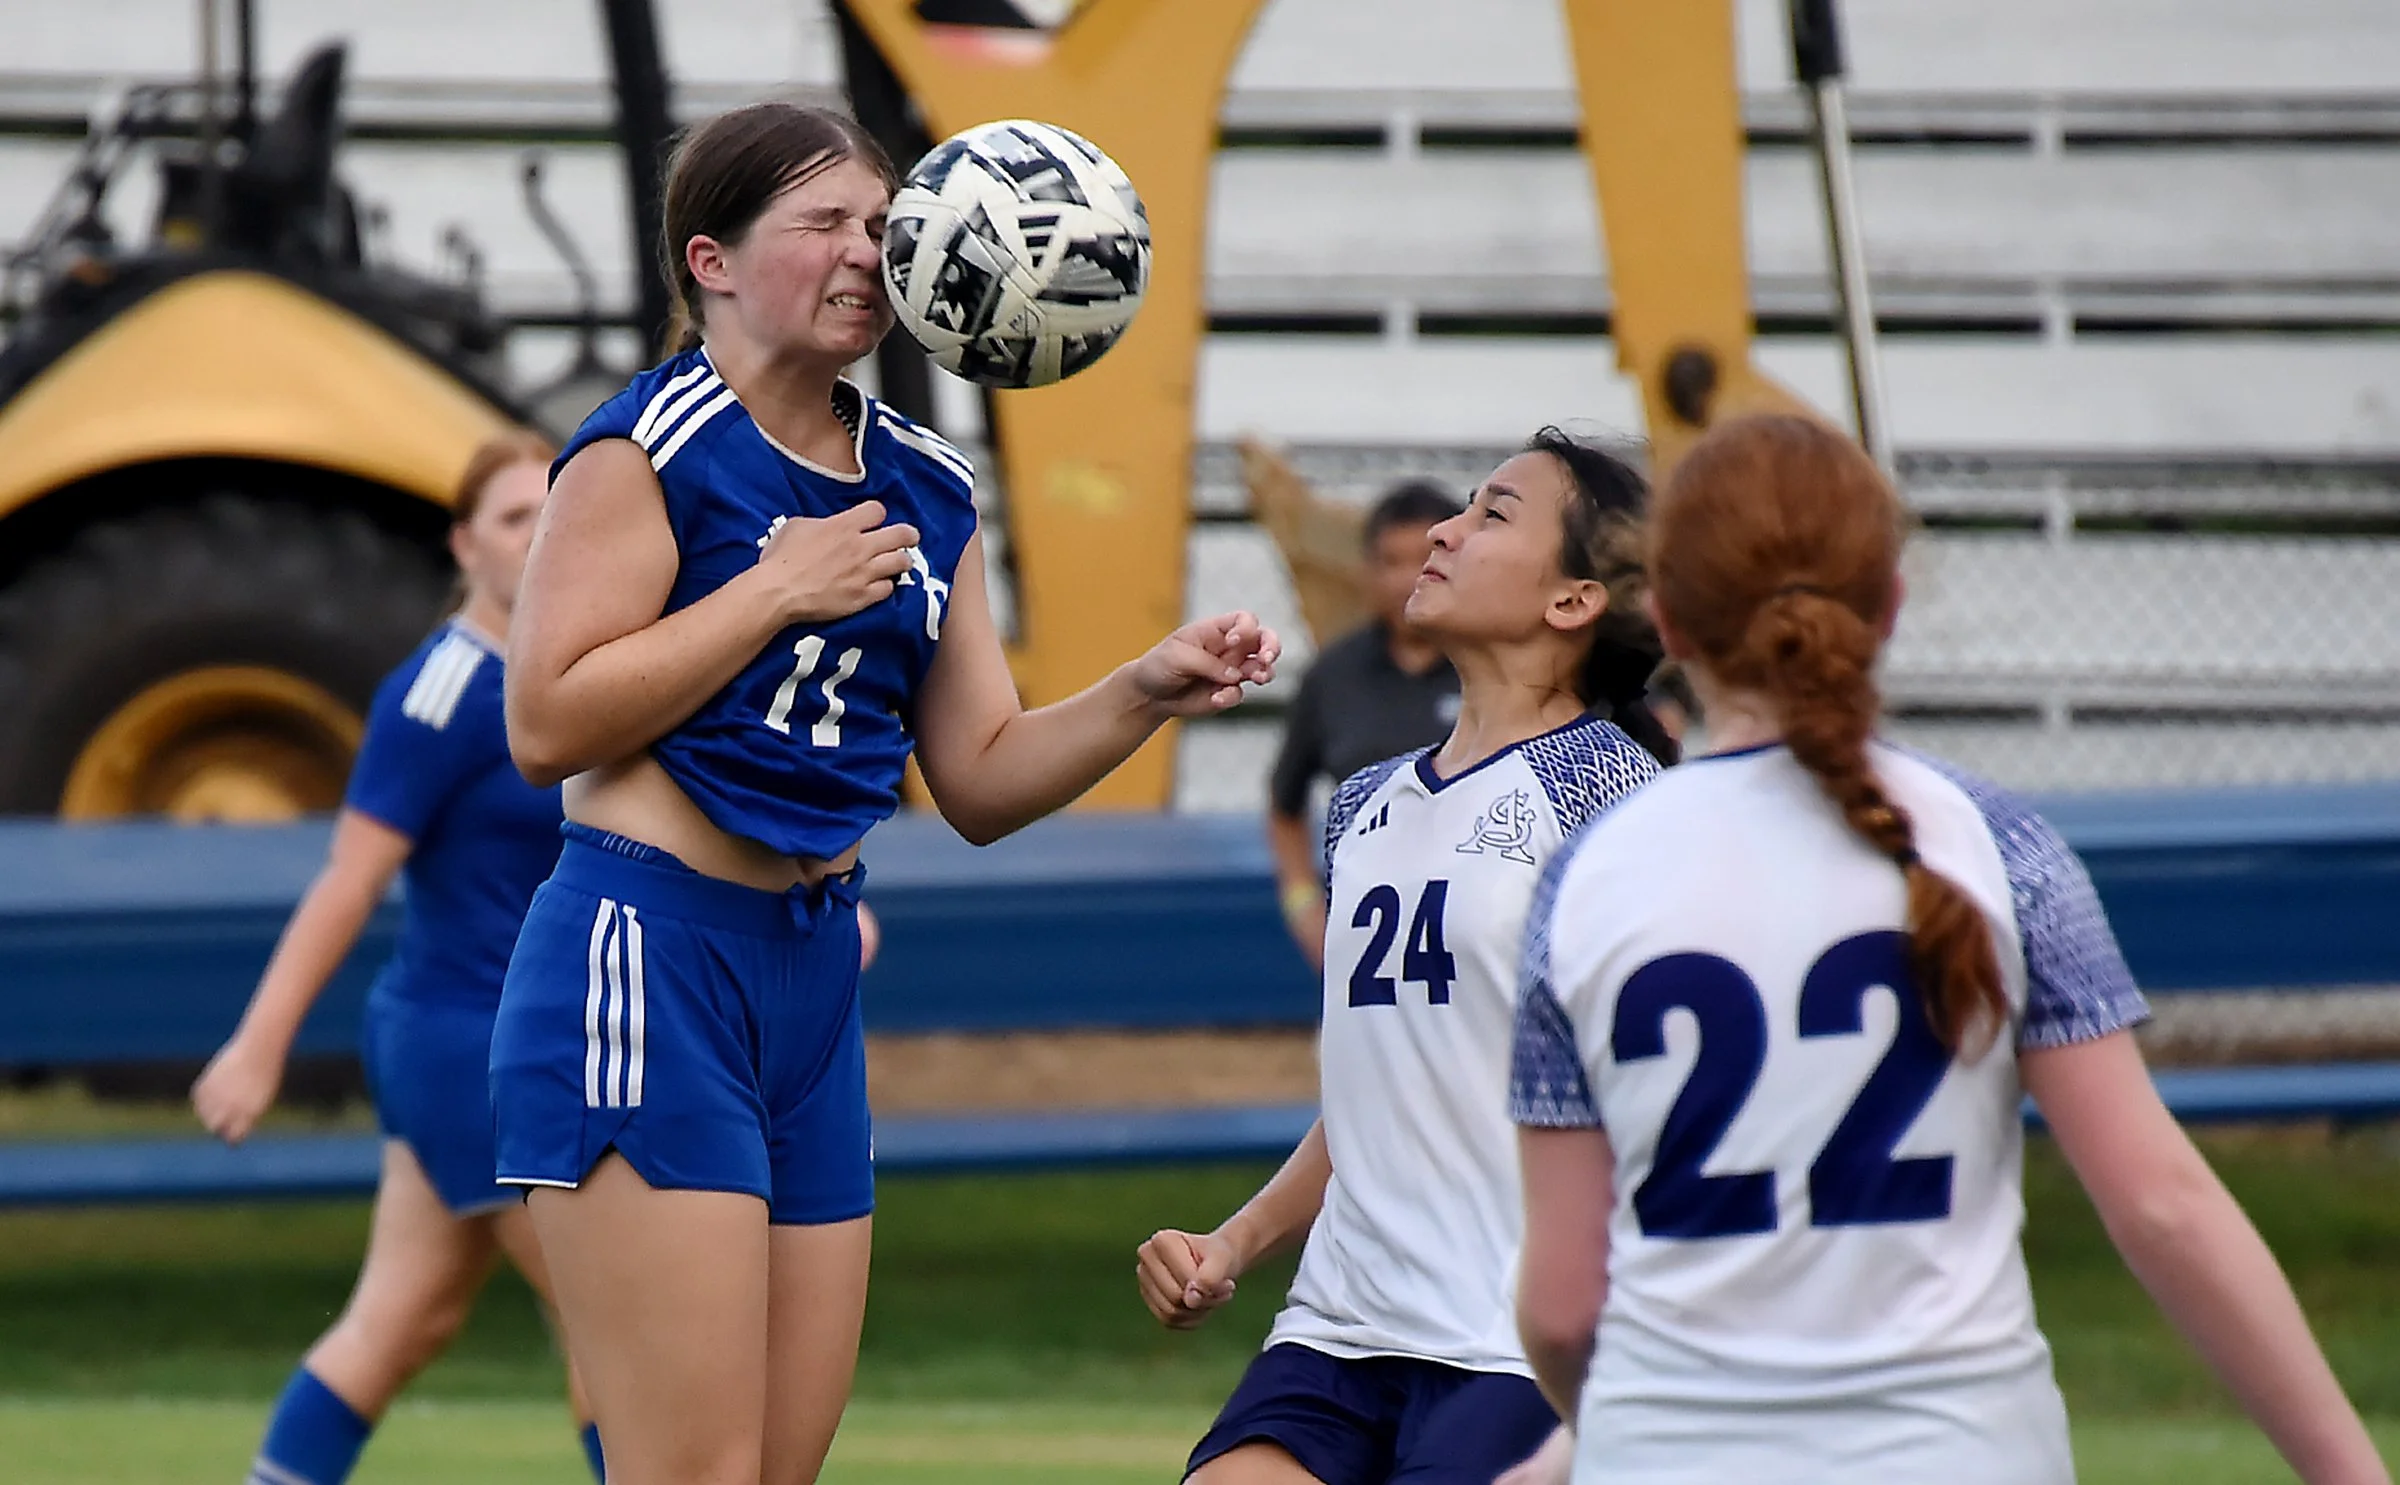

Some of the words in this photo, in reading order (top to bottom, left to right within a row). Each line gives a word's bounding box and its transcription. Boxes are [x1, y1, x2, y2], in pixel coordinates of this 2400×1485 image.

[763, 634, 862, 748] 11
[1348, 879, 1456, 1008] 24
[1612, 929, 1955, 1238] 22
